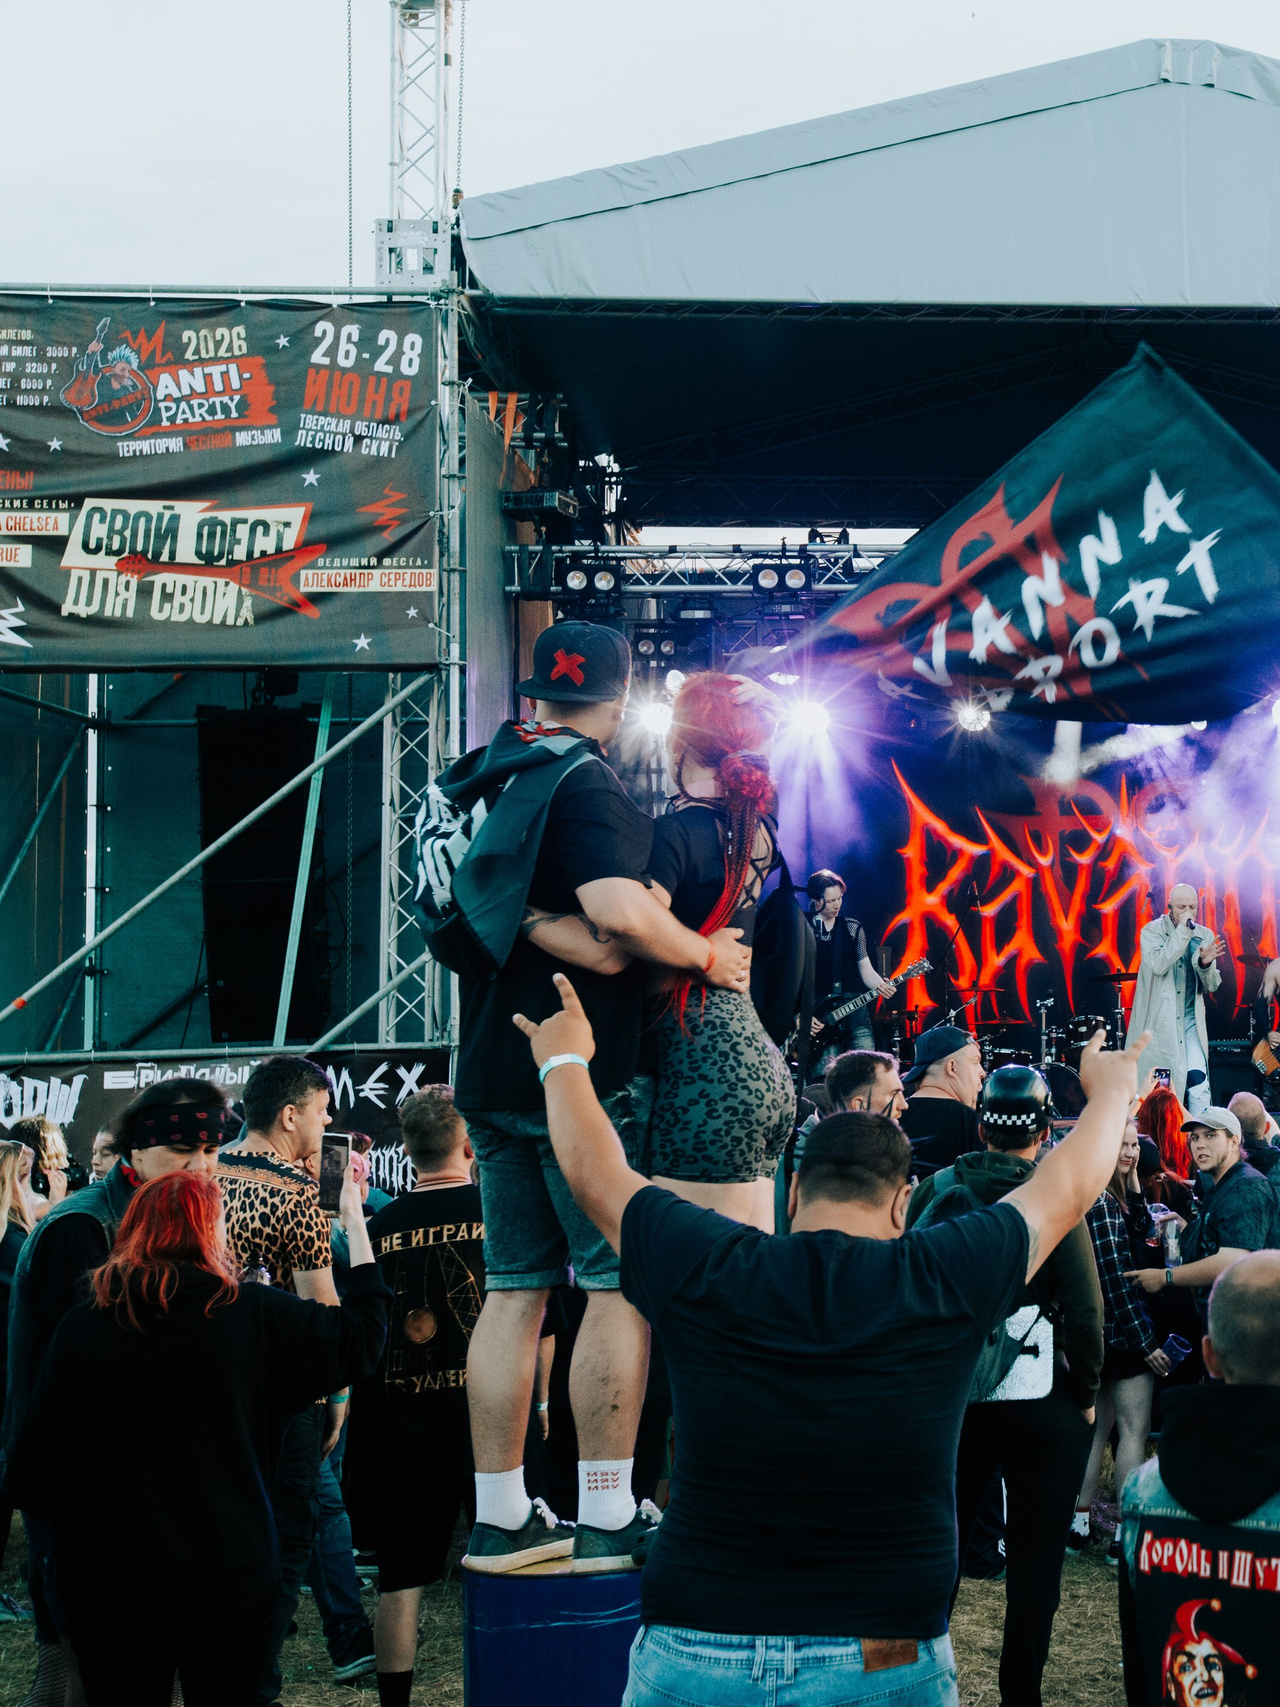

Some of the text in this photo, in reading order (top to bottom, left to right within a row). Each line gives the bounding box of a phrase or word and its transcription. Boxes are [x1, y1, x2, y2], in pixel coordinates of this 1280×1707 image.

[11, 345, 38, 357] БИЛЕТ
[46, 346, 69, 358] 3000
[182, 325, 248, 361] 2026
[311, 321, 423, 376] 26-28
[25, 362, 48, 374] 3200
[21, 378, 43, 390] 6000
[155, 363, 252, 400] ANTI-
[16, 394, 40, 406] 11000
[303, 368, 413, 422] ИЮНЯ
[158, 395, 241, 427] PARTY
[300, 413, 351, 434] ТВЕРСКАЯ
[117, 437, 184, 457] ТЕРРИТОРИЯ
[235, 428, 282, 447] МУЗЫКИ
[295, 430, 399, 458] ЛЕСНОЙ СКИТ
[6, 515, 59, 532] CHELSEA
[81, 504, 294, 562] СВОЙ ФЕСТ
[317, 556, 378, 567] ВЕДУЩИЙ
[303, 571, 374, 589] АЛЕКСАНДР
[61, 569, 138, 618] ДЛЯ
[381, 1232, 403, 1254] НЕ
